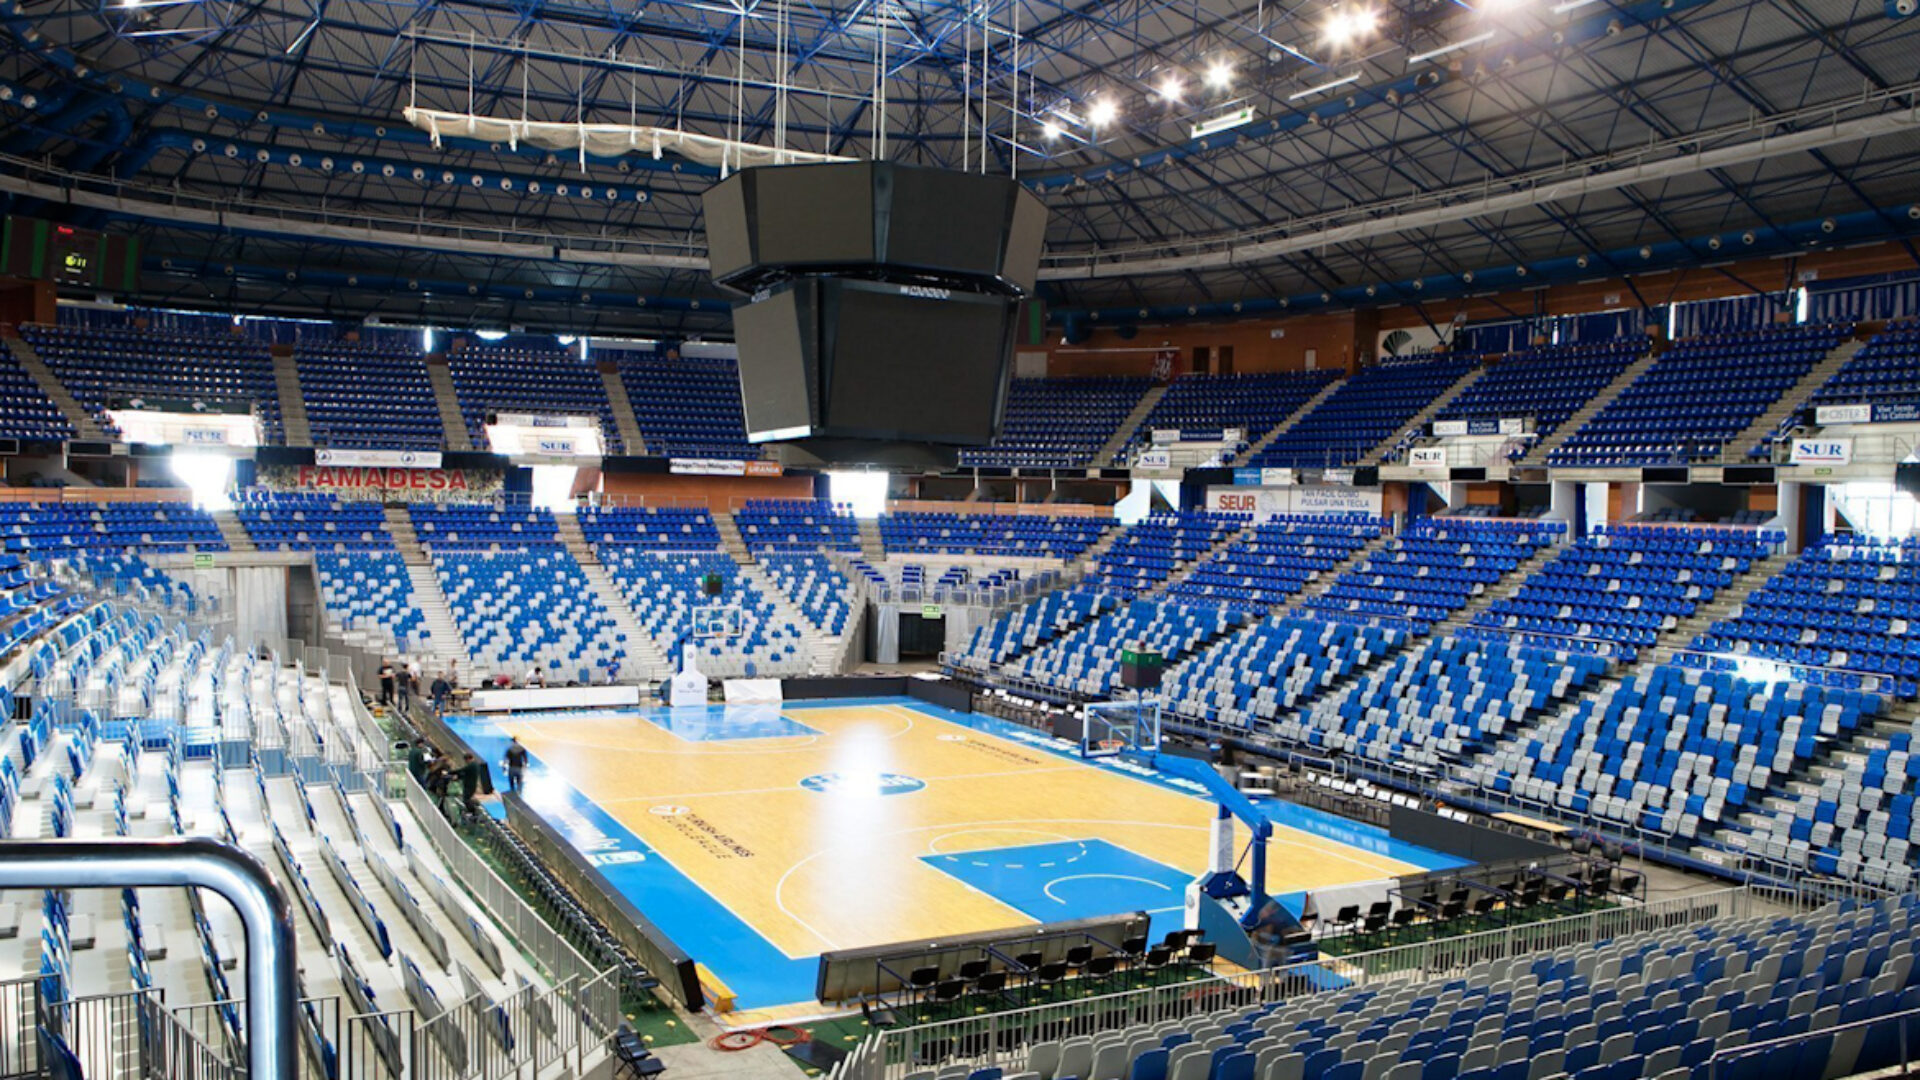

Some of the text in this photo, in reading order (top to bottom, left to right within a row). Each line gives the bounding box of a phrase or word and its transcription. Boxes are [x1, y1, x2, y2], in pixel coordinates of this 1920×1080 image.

[1799, 443, 1842, 456] SUR
[299, 466, 467, 489] FAMADESA
[1219, 495, 1256, 510] SEUR
[1301, 499, 1370, 508] PULSAR UNA TECLA
